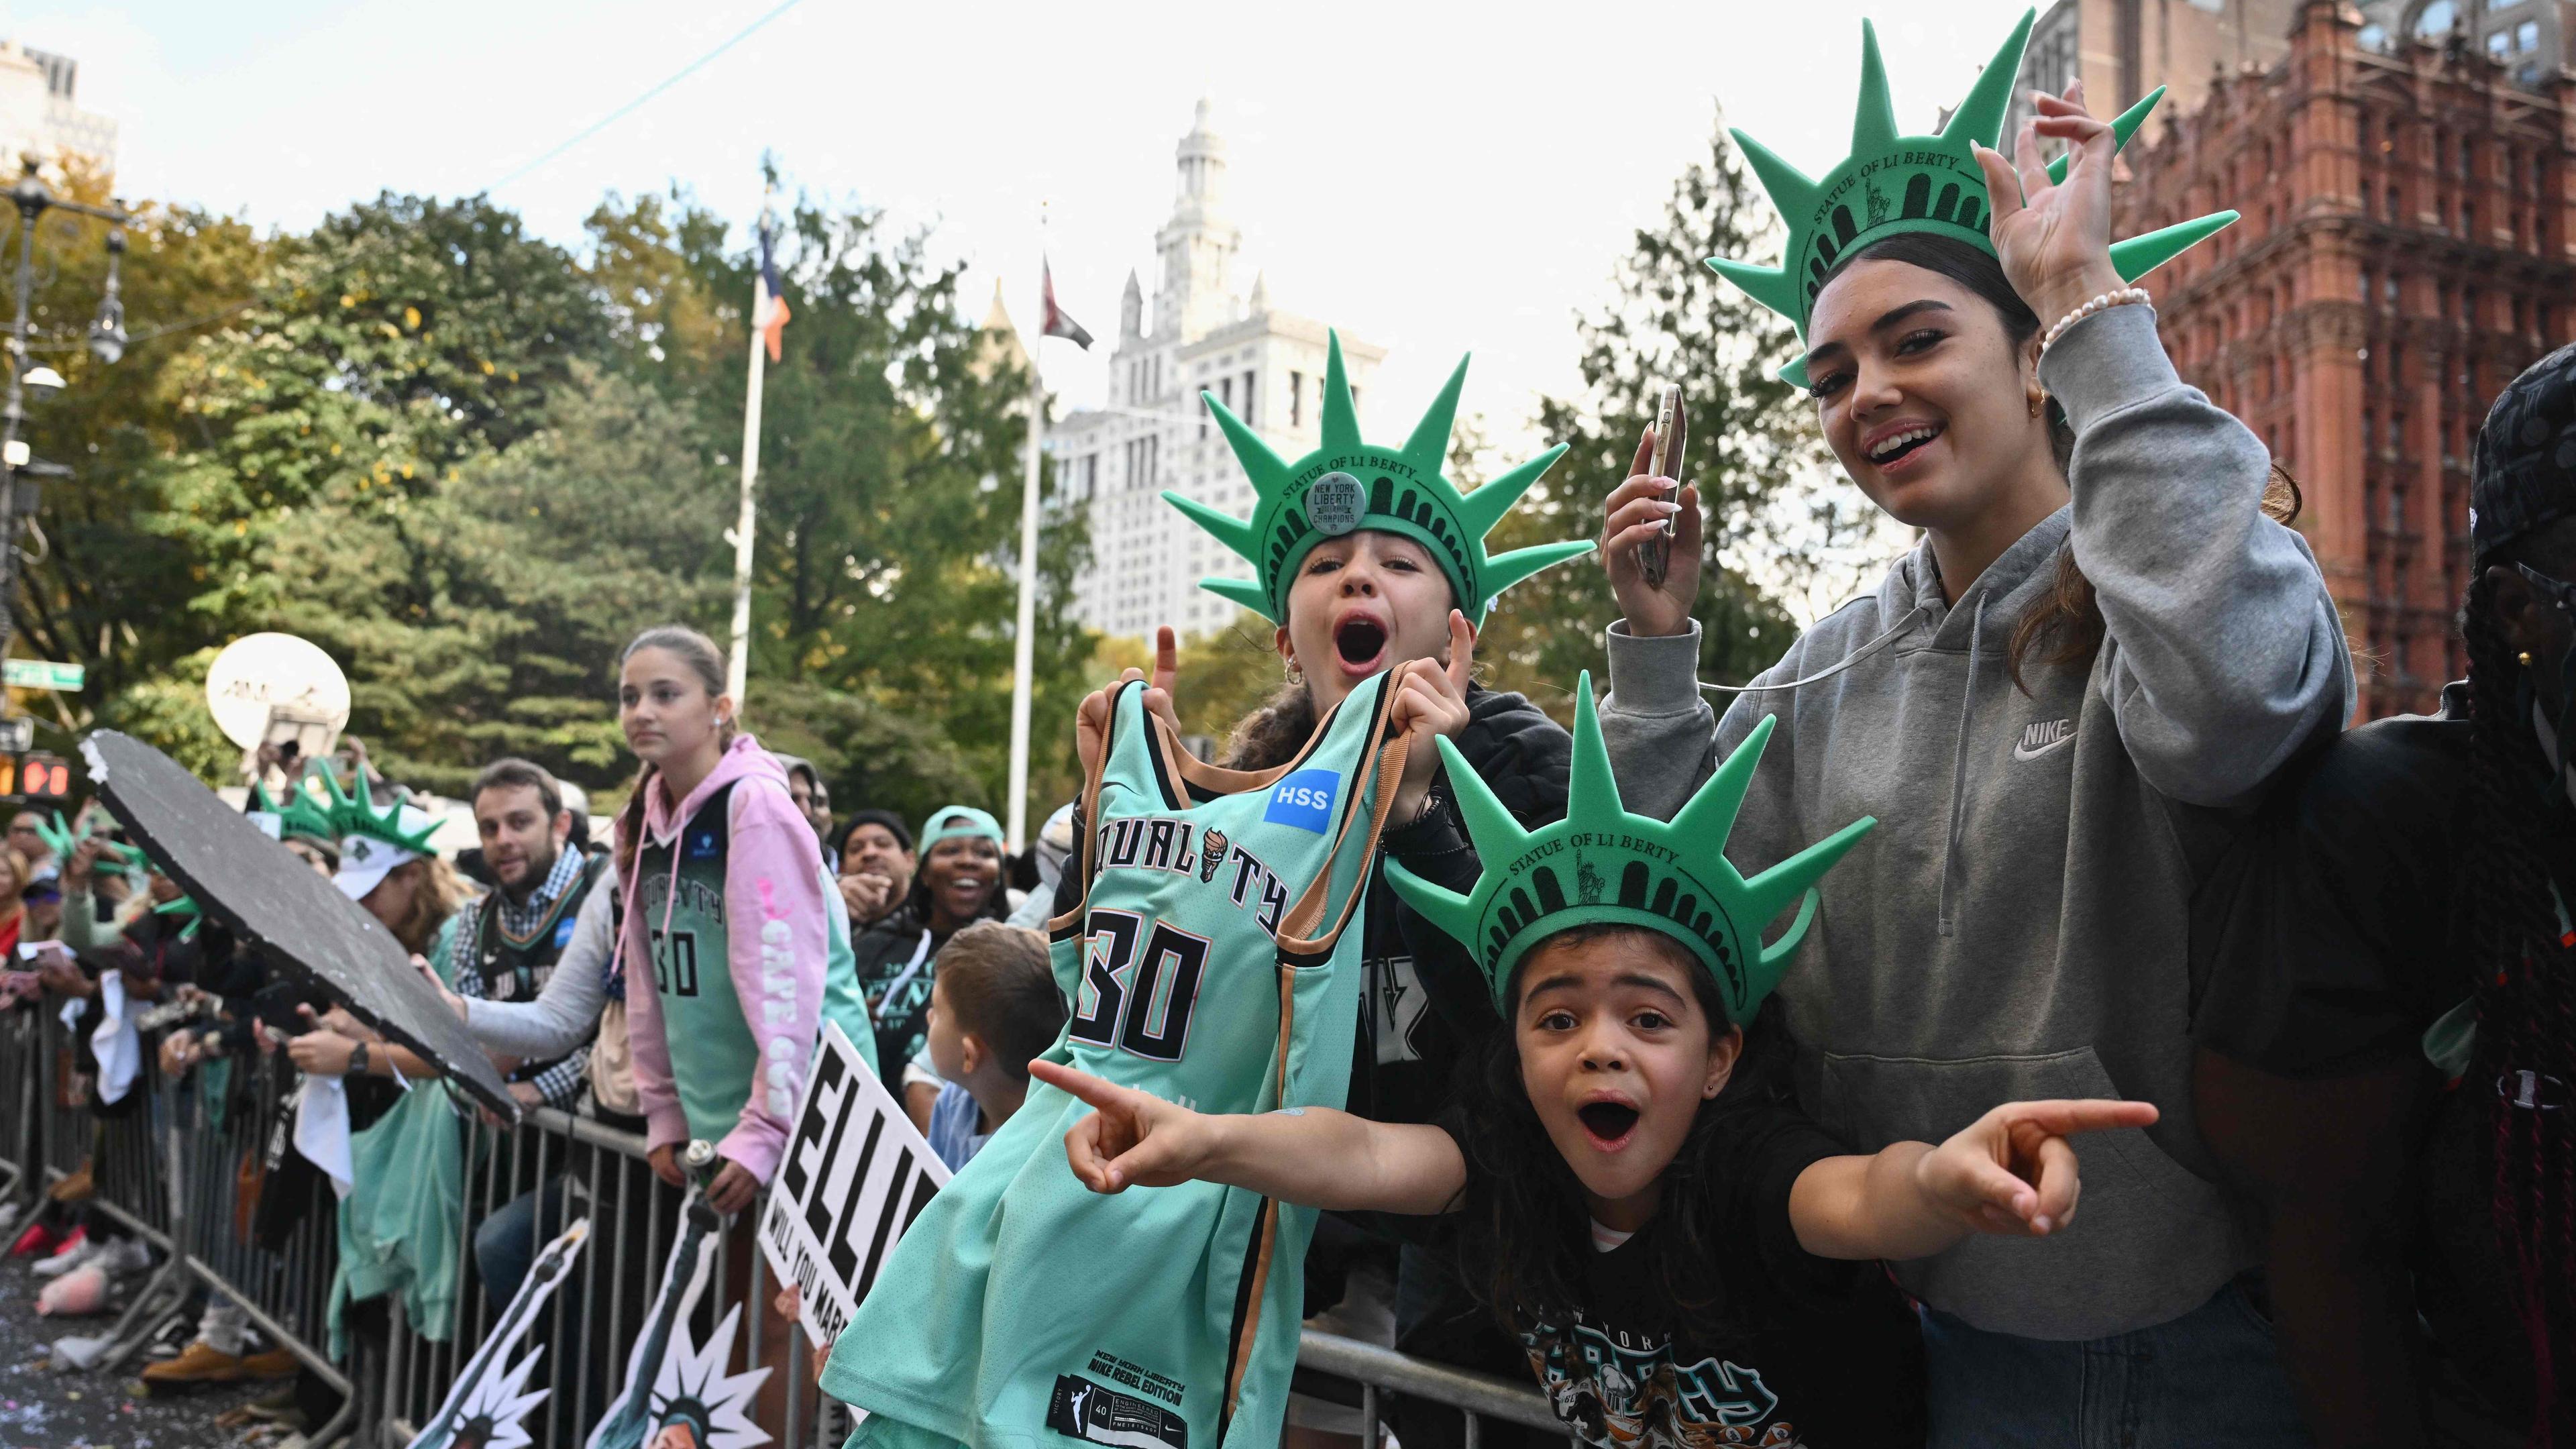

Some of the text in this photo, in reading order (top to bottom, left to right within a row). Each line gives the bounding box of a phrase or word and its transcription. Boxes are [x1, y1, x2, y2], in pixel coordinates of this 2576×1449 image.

[1813, 174, 1856, 225] STATUE
[1860, 159, 1880, 178] OF
[1283, 464, 1326, 499] STATUE
[1330, 457, 1346, 470] OF
[1315, 484, 1355, 493] NEW YORK
[1314, 494, 1355, 504] LIBERTY
[1313, 515, 1355, 523] CHAMPIONS
[2023, 718, 2069, 745] NIKE
[1277, 787, 1329, 810] HSS
[1509, 839, 1564, 876] STATUE
[1570, 833, 1593, 848] OF
[1068, 908, 1213, 1063] 30
[784, 1041, 941, 1309] ELLI
[767, 1197, 794, 1263] WILL
[790, 1239, 818, 1302] YOU
[1087, 1357, 1183, 1407] NIKE REBEL EDITION
[1094, 1349, 1186, 1392] NEW YORK LIBERTY
[1053, 1387, 1063, 1415] VICTORY
[1095, 1404, 1107, 1415] 40
[1115, 1399, 1159, 1415] ENGINEERED
